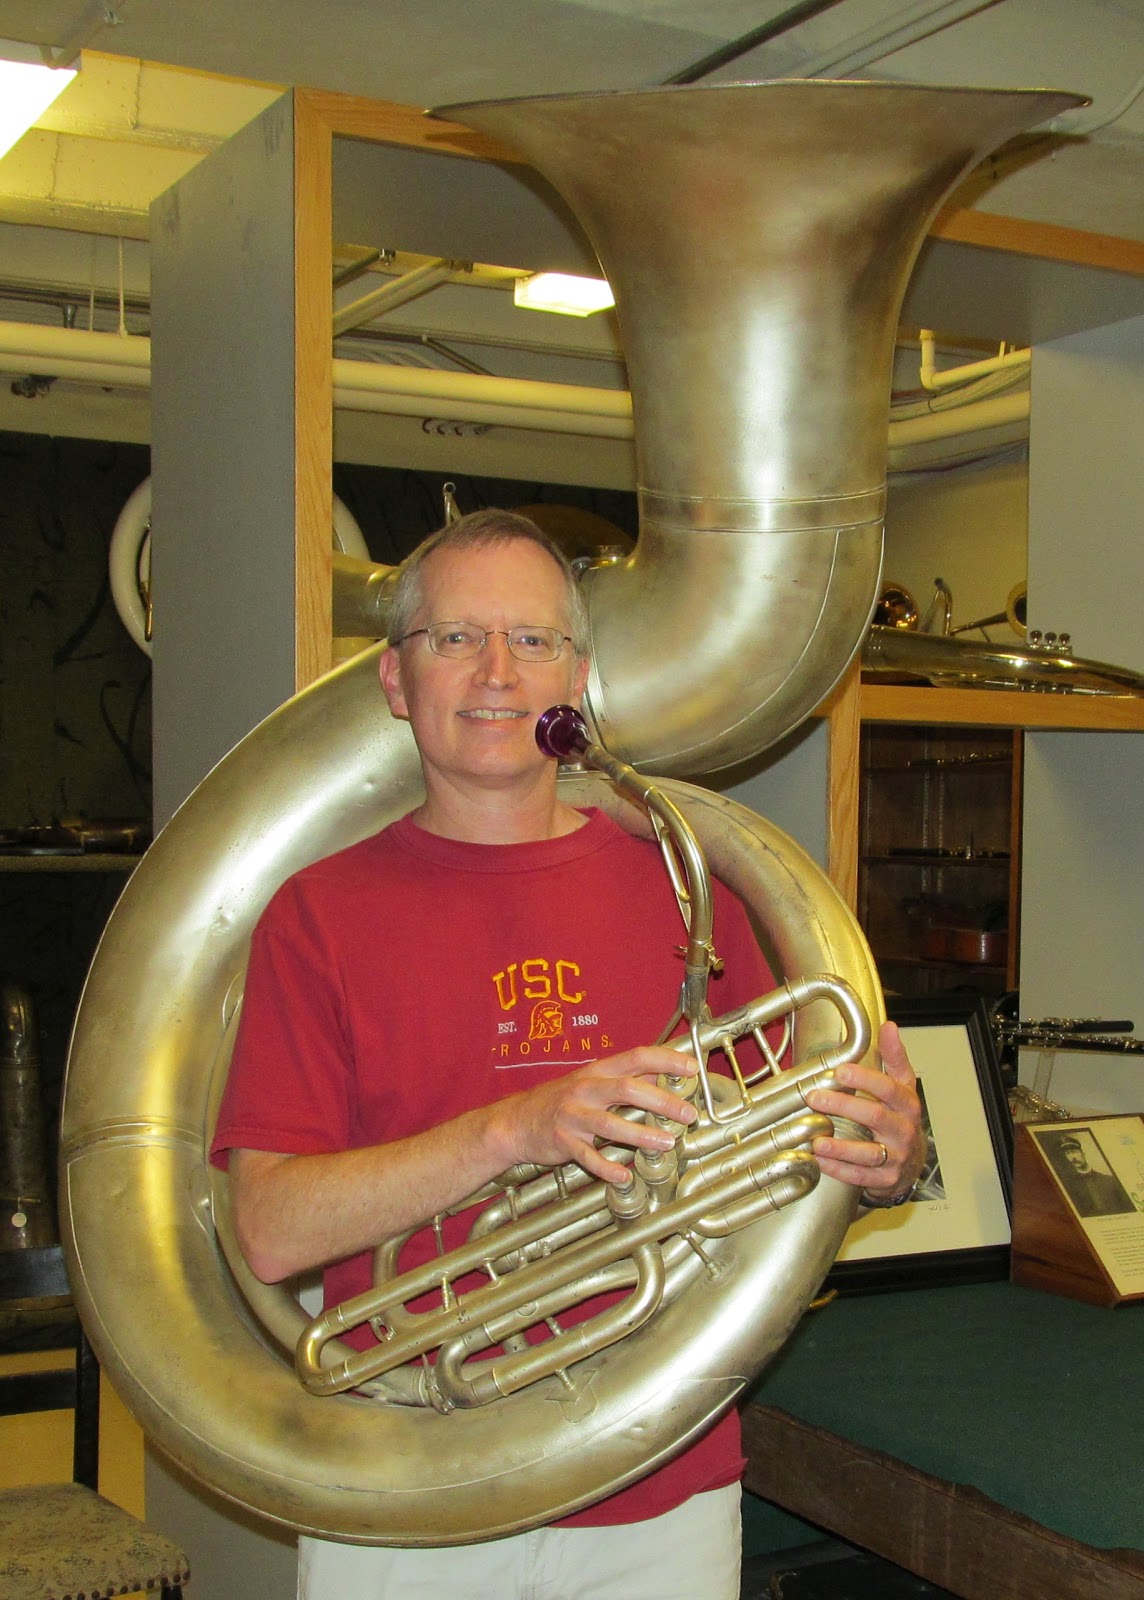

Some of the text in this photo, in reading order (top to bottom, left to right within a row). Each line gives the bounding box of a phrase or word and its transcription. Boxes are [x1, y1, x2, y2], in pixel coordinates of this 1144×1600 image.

[492, 958, 583, 1010] USC
[497, 1014, 599, 1034] EST. 1880
[491, 1035, 610, 1057] ROJANS
